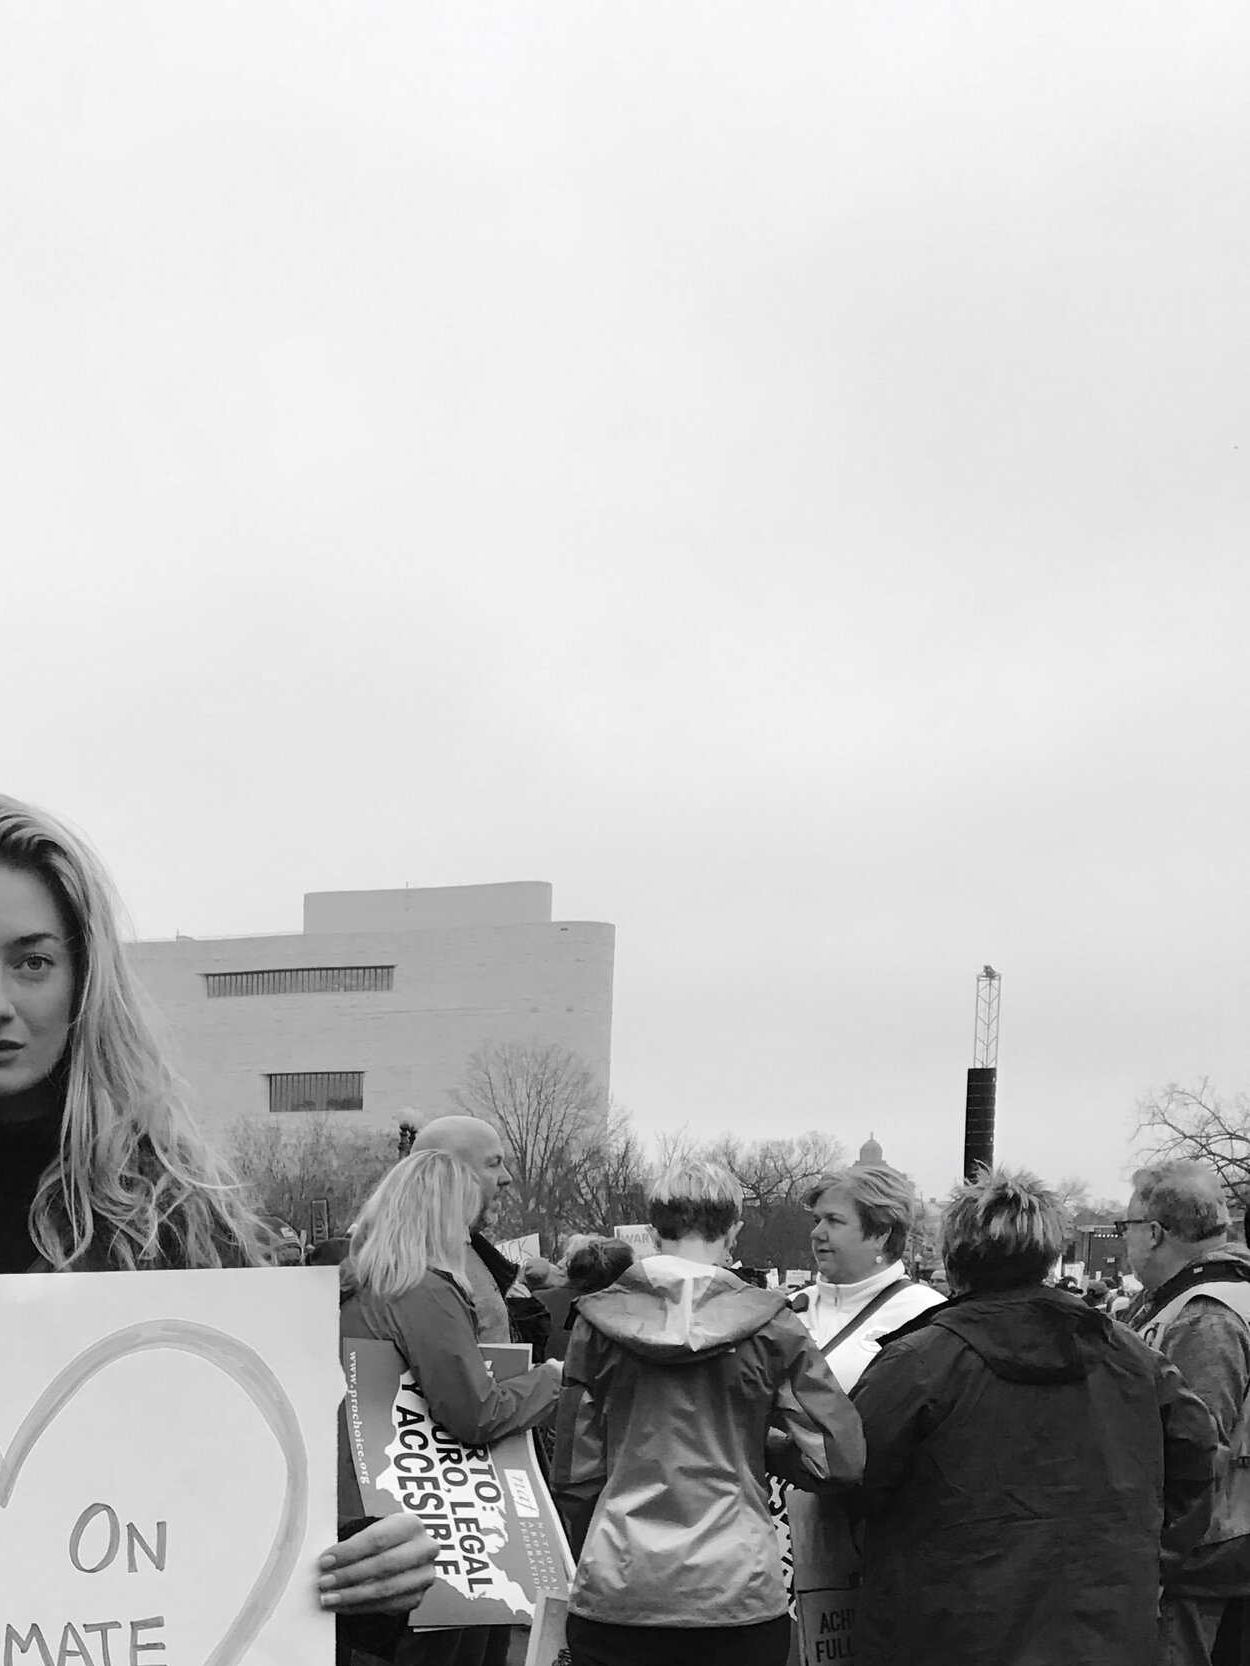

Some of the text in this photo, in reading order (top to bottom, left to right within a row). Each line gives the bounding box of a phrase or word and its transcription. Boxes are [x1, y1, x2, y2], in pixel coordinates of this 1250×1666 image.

[349, 1351, 370, 1486] www.prochoice.org
[430, 1424, 493, 1593] URO, LEGAL
[463, 1443, 503, 1512] RTO:
[69, 1502, 167, 1573] ON
[538, 1521, 560, 1592] NATIONAL
